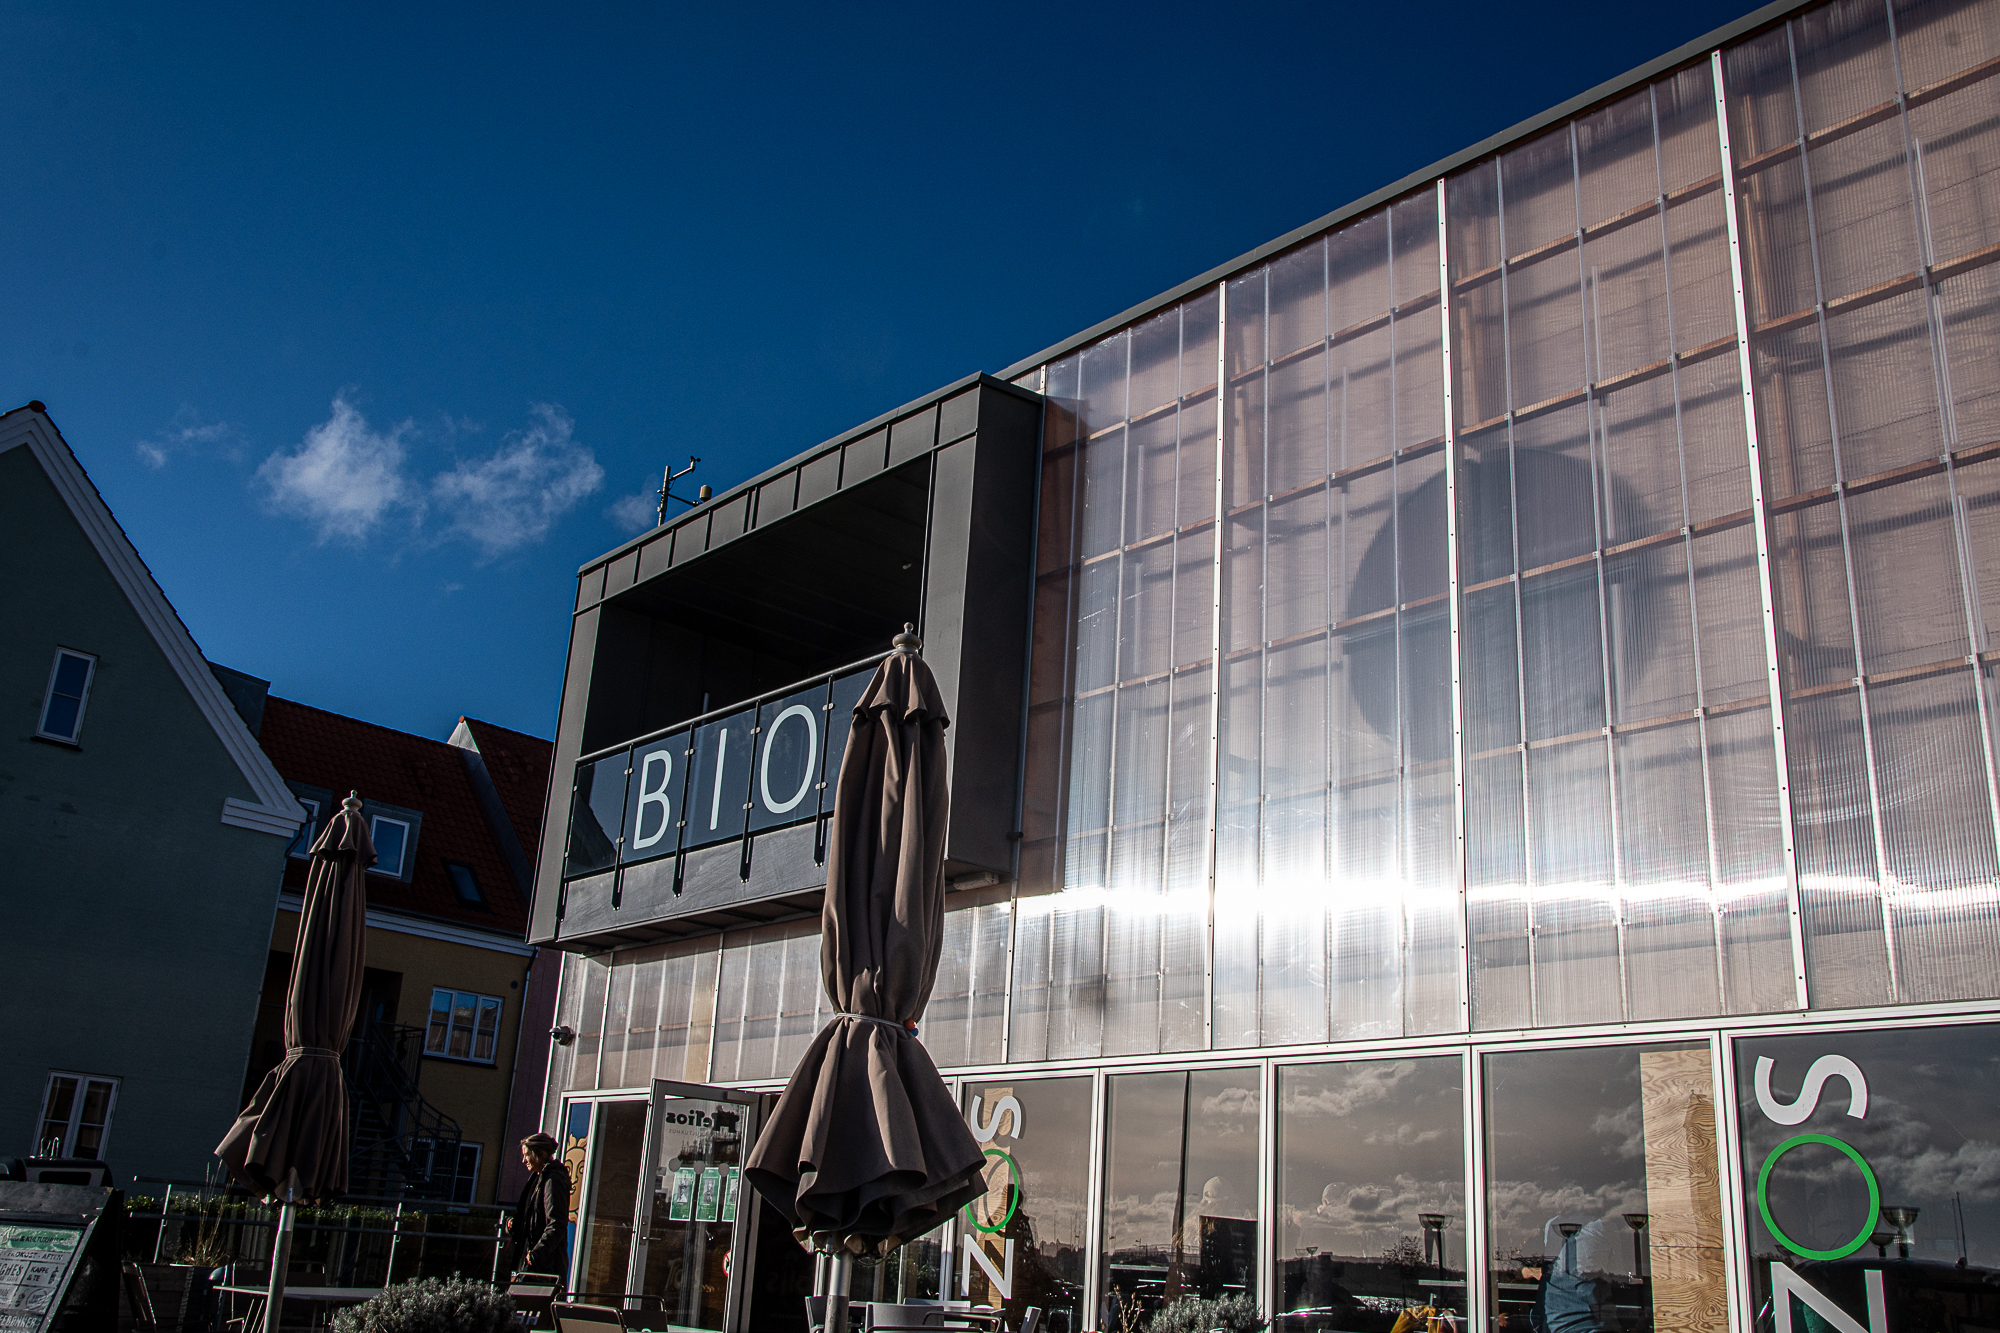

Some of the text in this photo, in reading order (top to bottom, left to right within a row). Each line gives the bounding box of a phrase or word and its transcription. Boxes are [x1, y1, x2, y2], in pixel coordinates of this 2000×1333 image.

[633, 704, 817, 850] BIO
[30, 1266, 50, 1274] KAFFE
[32, 1274, 41, 1282] TE
